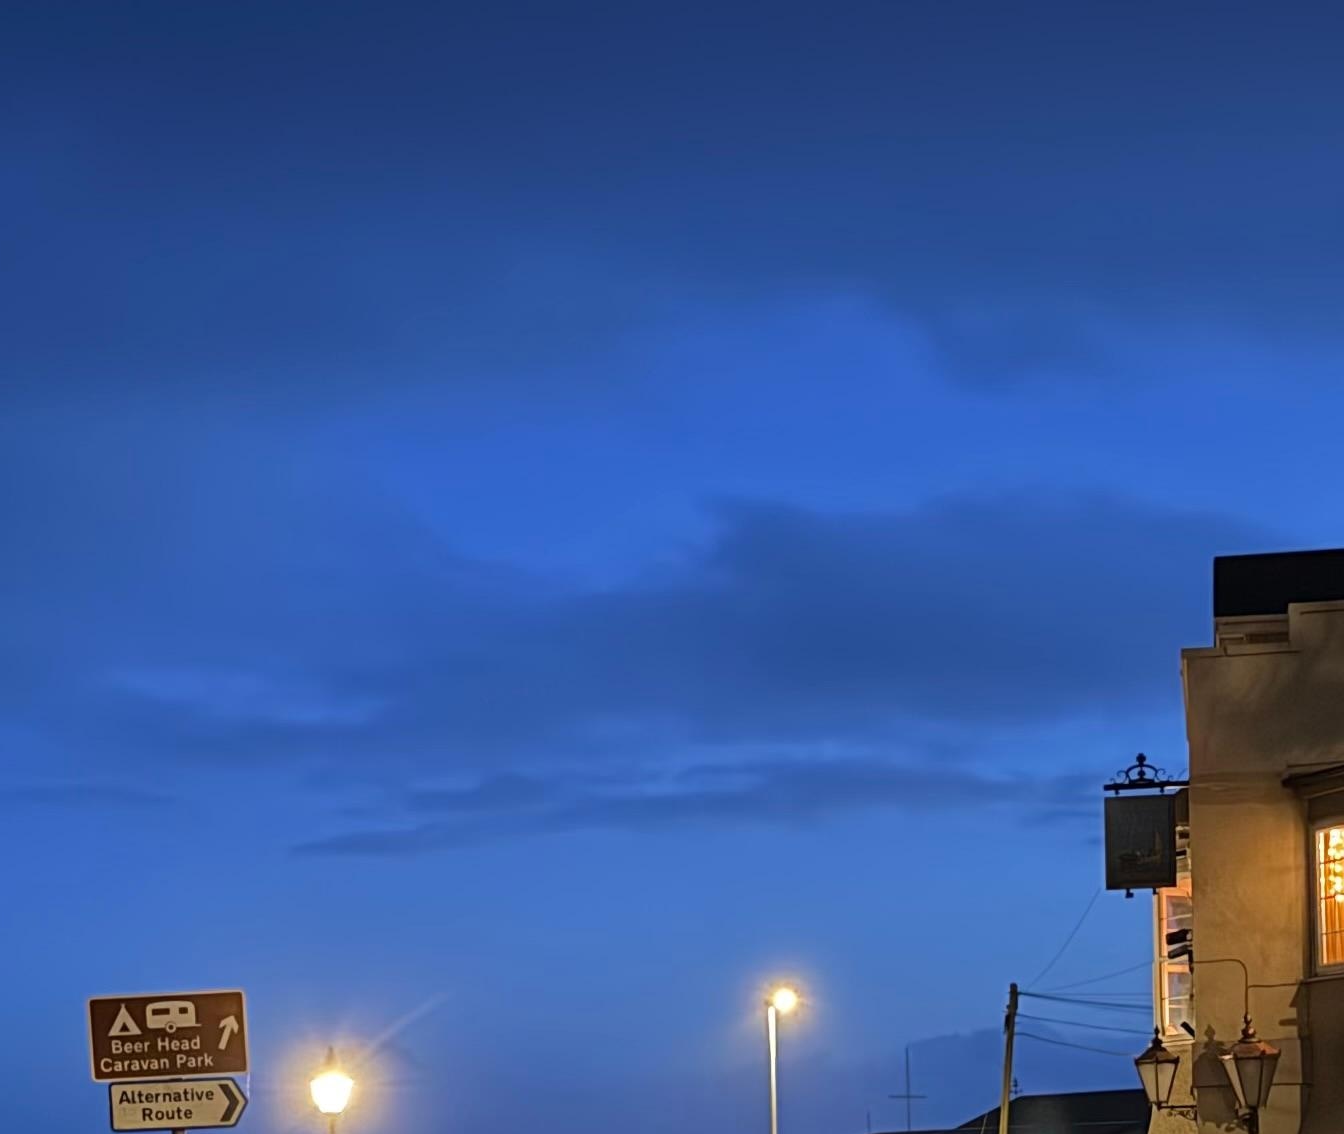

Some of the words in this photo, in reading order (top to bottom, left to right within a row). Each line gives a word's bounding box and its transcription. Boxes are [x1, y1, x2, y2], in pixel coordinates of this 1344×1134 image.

[111, 1040, 151, 1055] Beer
[157, 1036, 201, 1051] Head
[100, 1056, 170, 1073] Caravan
[176, 1053, 214, 1069] Park
[118, 1088, 215, 1105] Alternative
[142, 1107, 193, 1121] Route
